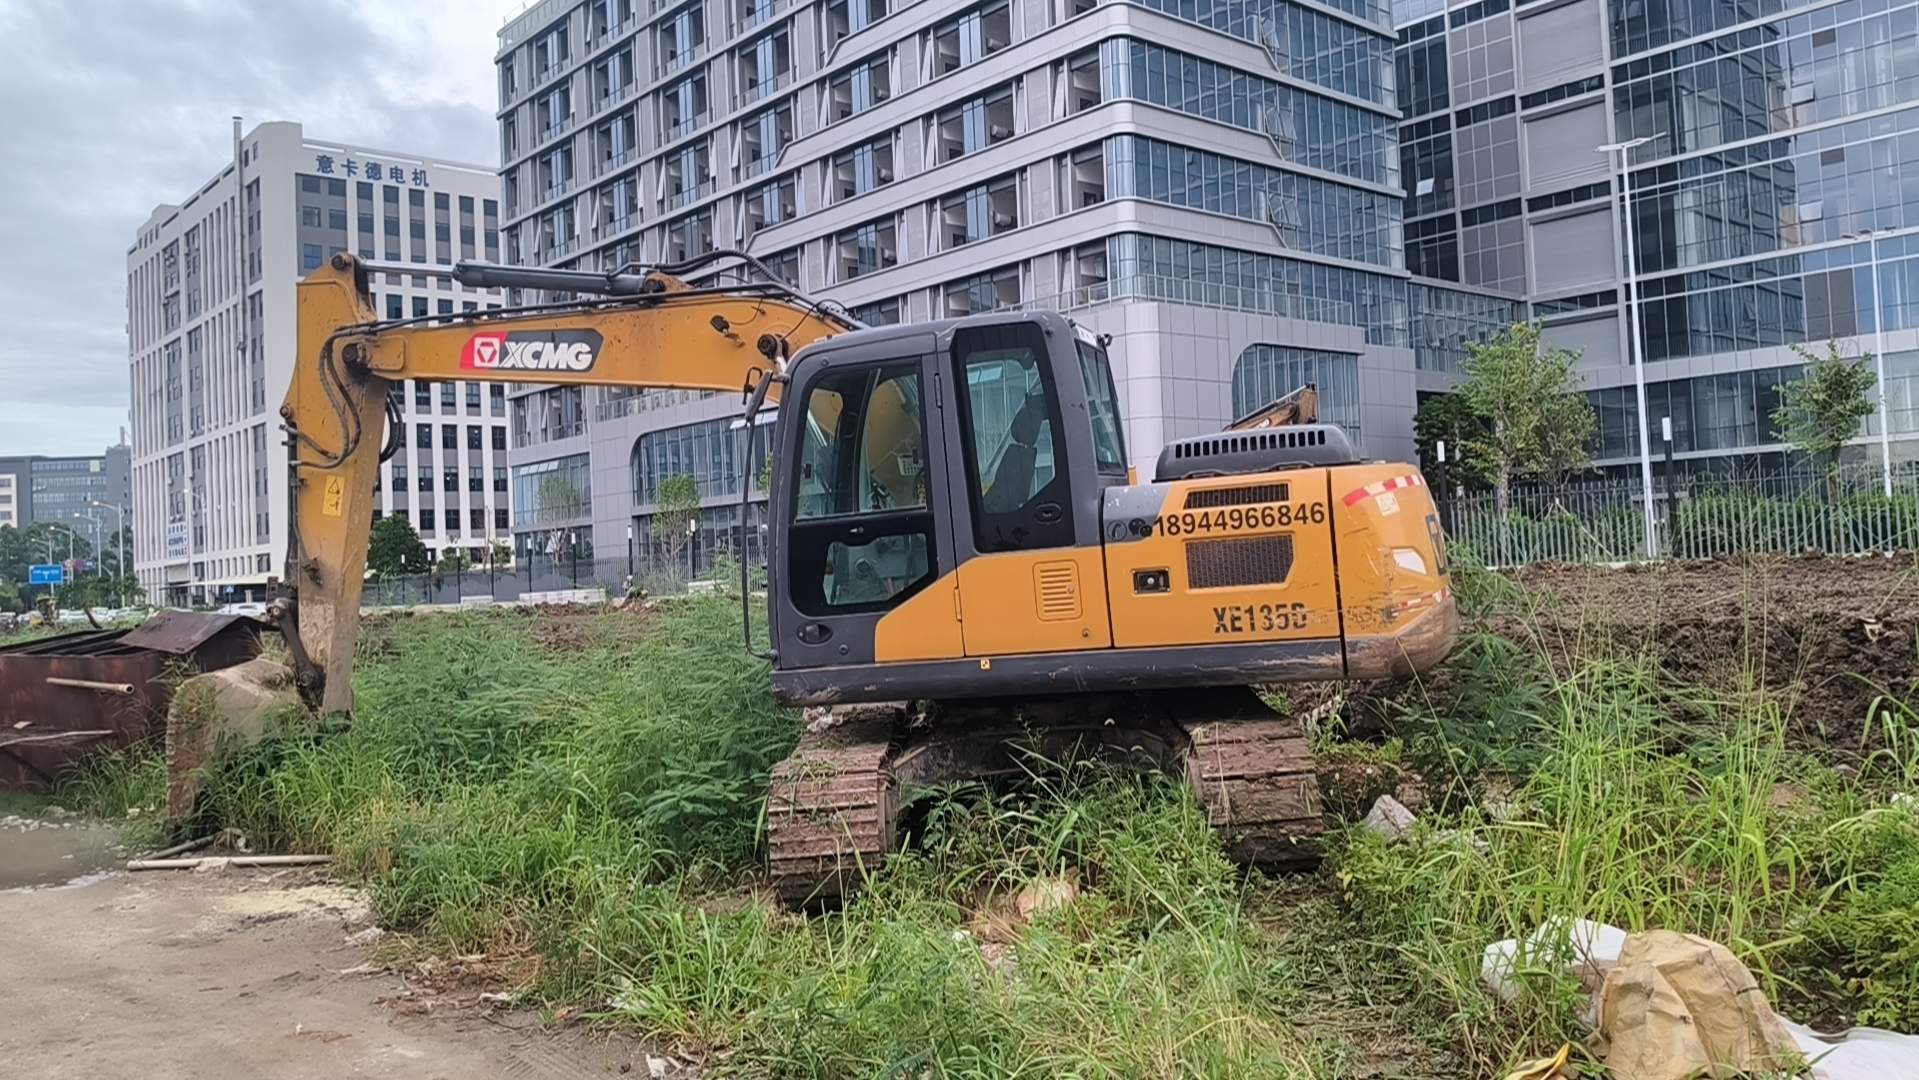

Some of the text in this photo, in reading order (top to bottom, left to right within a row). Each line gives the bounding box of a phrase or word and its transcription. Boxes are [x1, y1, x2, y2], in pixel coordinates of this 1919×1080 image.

[315, 154, 429, 187] 意卡德电机
[499, 341, 593, 371] XCMG
[1153, 502, 1325, 537] 18944966846
